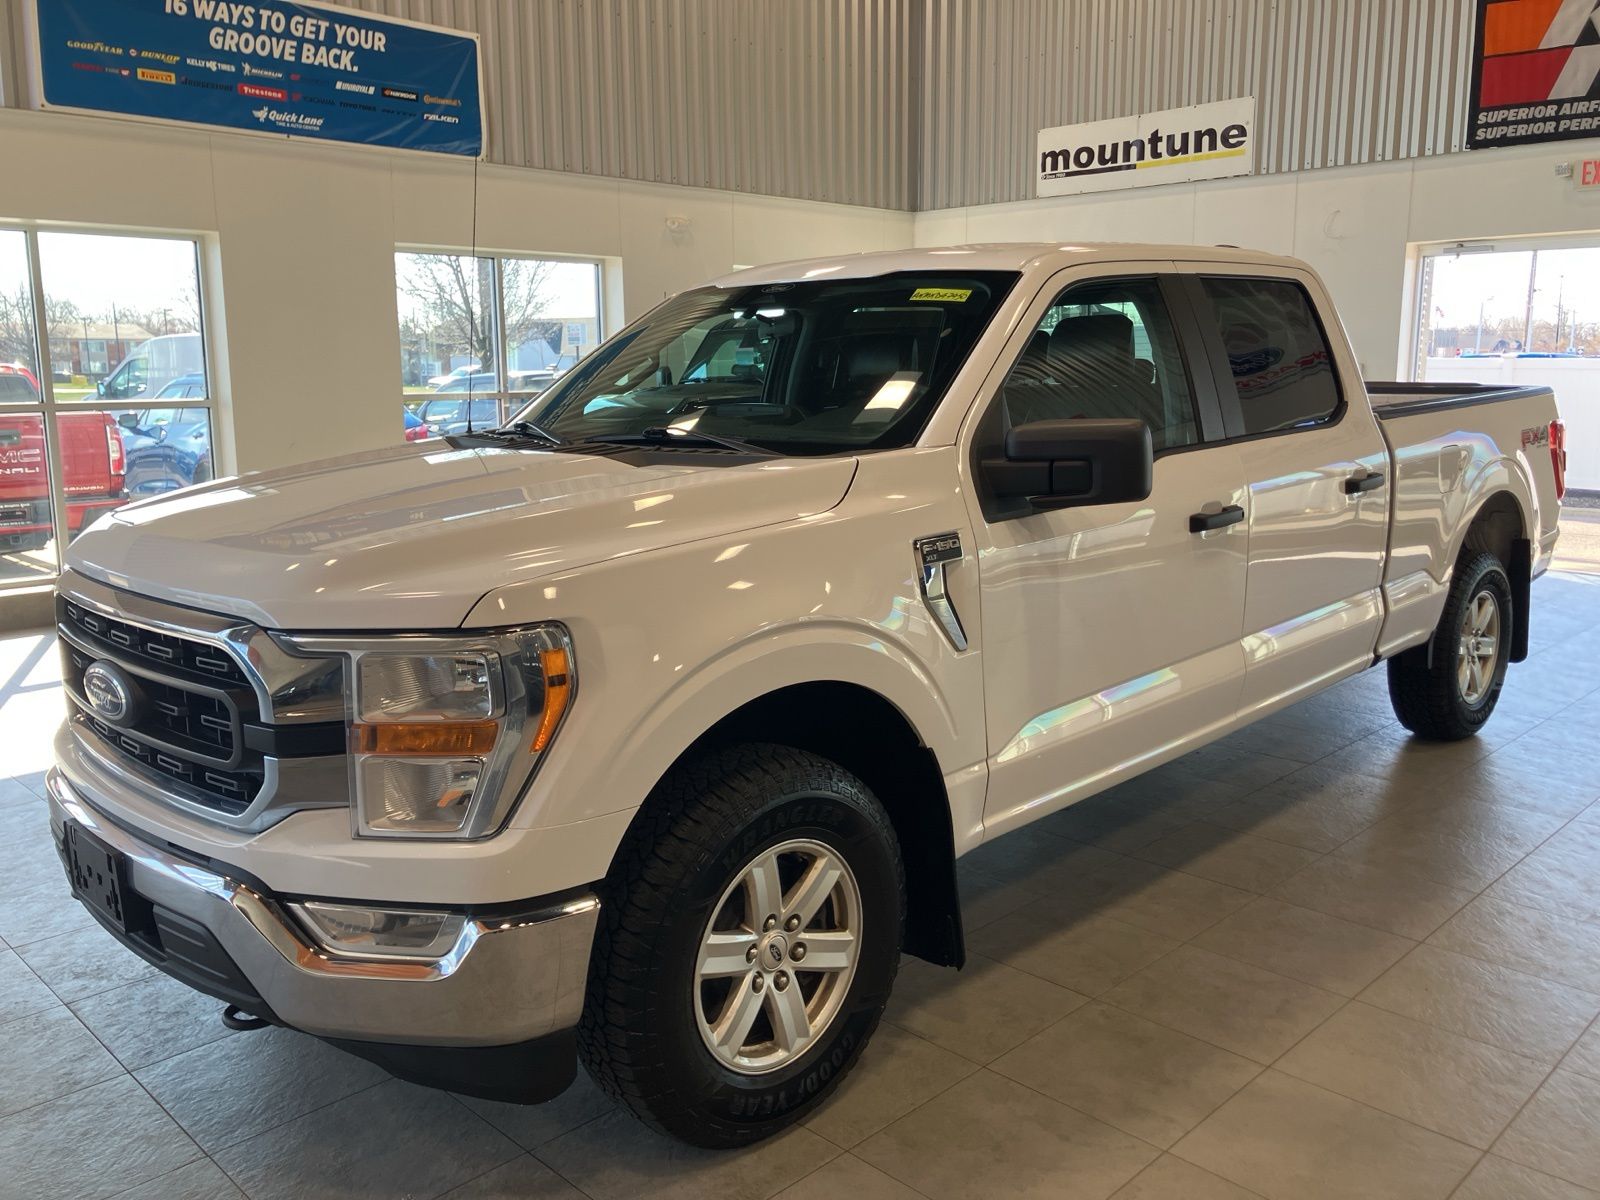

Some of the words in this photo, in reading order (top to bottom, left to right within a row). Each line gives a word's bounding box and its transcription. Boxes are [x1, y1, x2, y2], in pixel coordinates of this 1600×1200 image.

[165, 0, 188, 16] 16
[193, 0, 254, 28] WAYS
[260, 9, 286, 34] TO
[290, 15, 330, 42] GET
[334, 23, 387, 52] YOUR
[66, 40, 124, 56] GOODYEAR
[140, 50, 180, 62] DUNLOP
[209, 26, 297, 62] GROOVE
[301, 43, 359, 73] BACK.
[186, 57, 206, 68] KELLY
[250, 68, 284, 79] MICHELIN
[268, 110, 298, 123] Quick
[298, 114, 325, 127] Lane
[1477, 104, 1558, 125] SUPERIOR
[1558, 99, 1600, 116] AIRF
[1475, 121, 1557, 141] SUPERIOR
[1558, 116, 1600, 133] PERF
[1040, 123, 1249, 174] mountune
[922, 540, 960, 554] F-150
